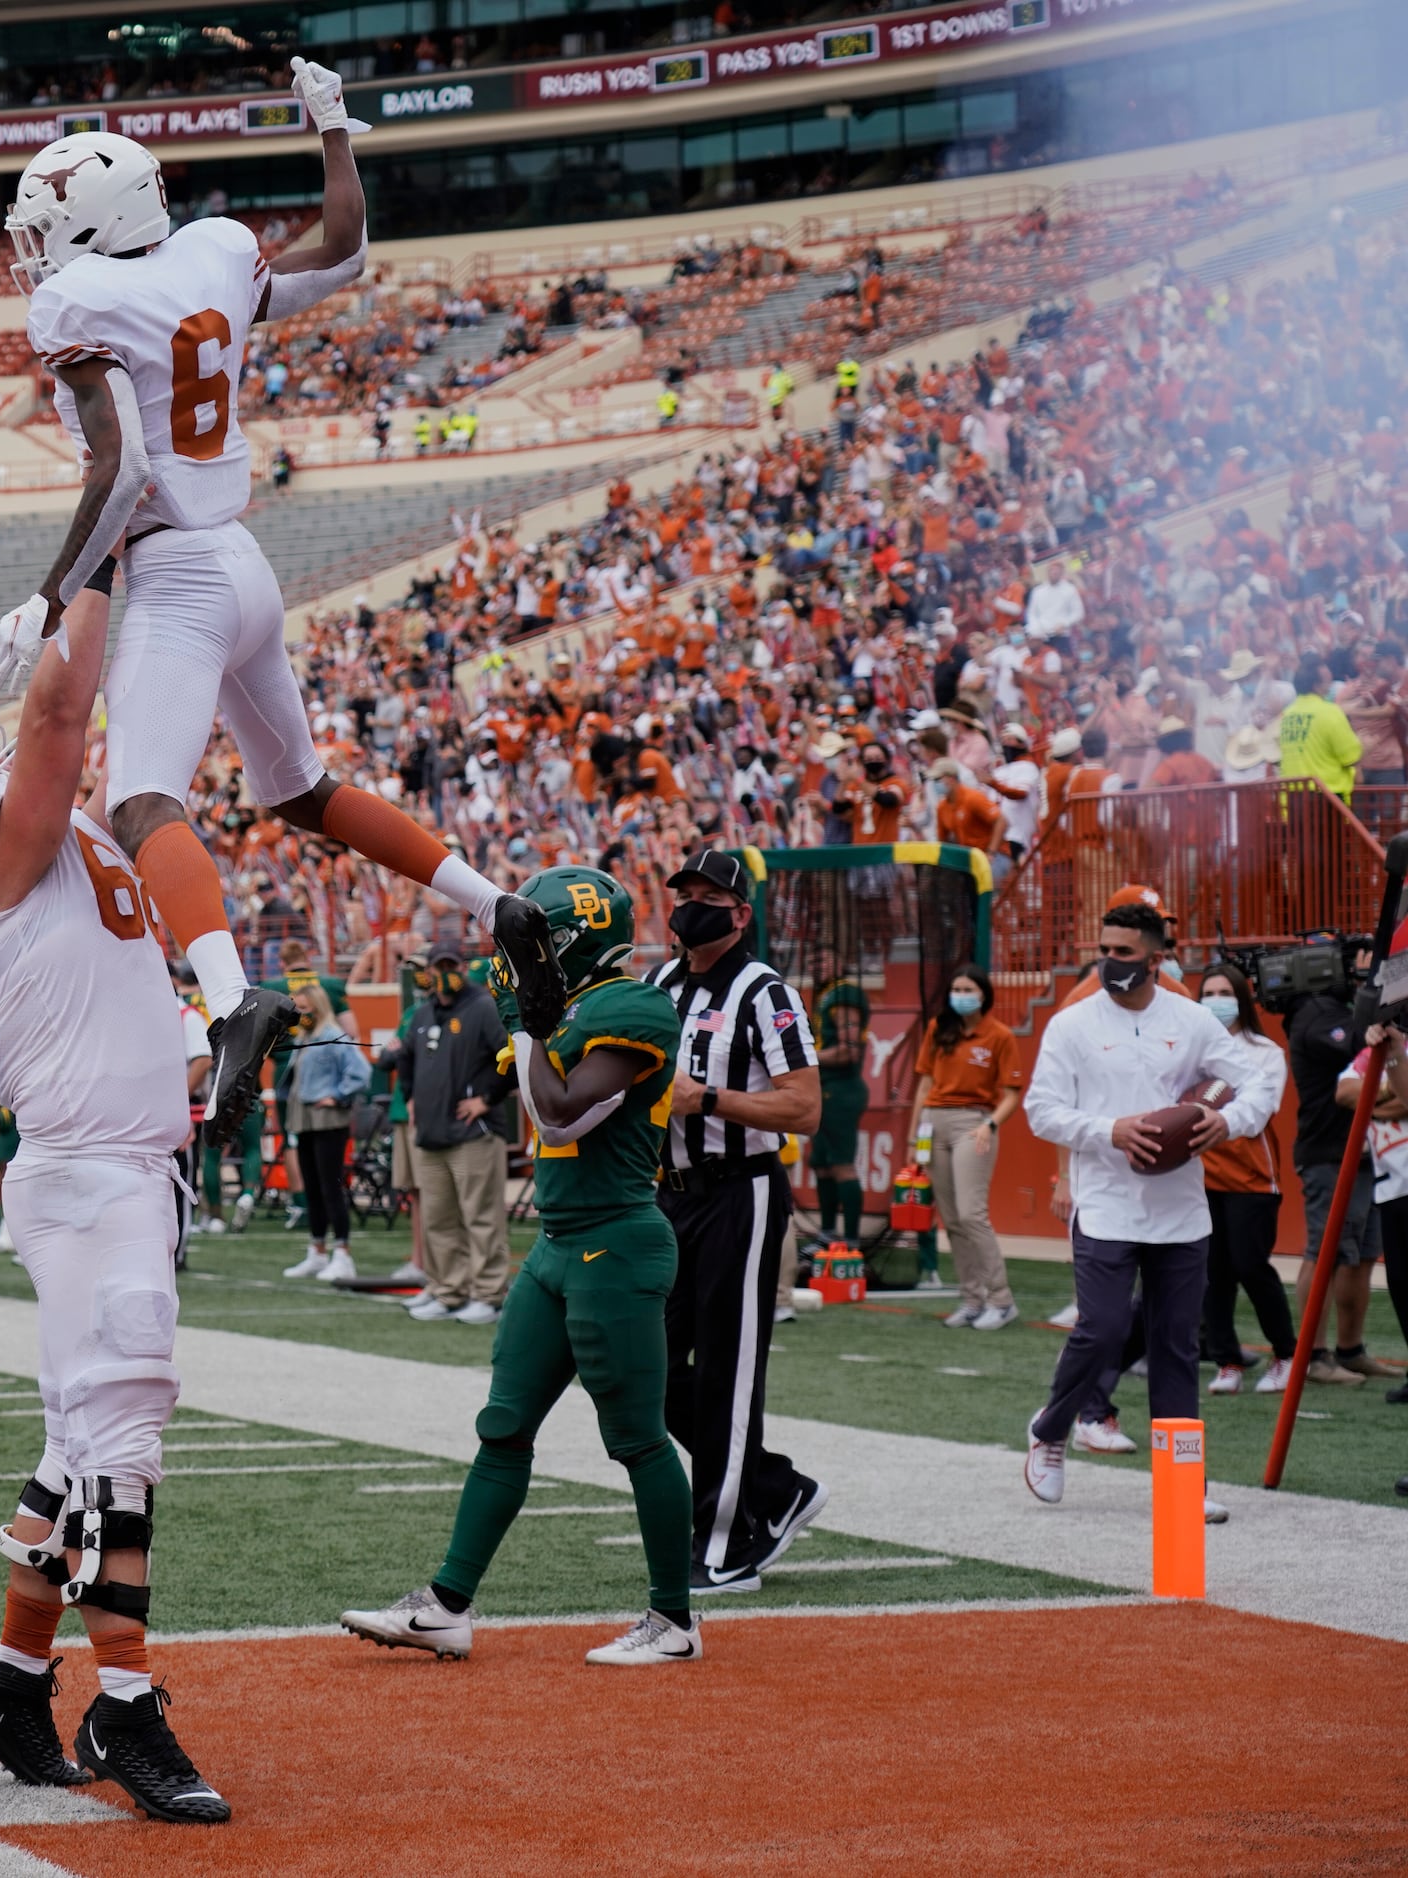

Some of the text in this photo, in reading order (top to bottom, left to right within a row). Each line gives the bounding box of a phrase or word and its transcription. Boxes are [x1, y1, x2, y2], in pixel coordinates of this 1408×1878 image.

[890, 22, 927, 49] 1ST
[930, 8, 1008, 43] DOWNS
[717, 47, 772, 77] PASS
[773, 39, 818, 67] YDS
[540, 70, 603, 99] RUSH
[604, 65, 650, 92] YDS
[381, 86, 474, 116] BAYLOR
[118, 114, 162, 138] TOT
[168, 108, 240, 134] PLAYS
[170, 307, 232, 461] 6
